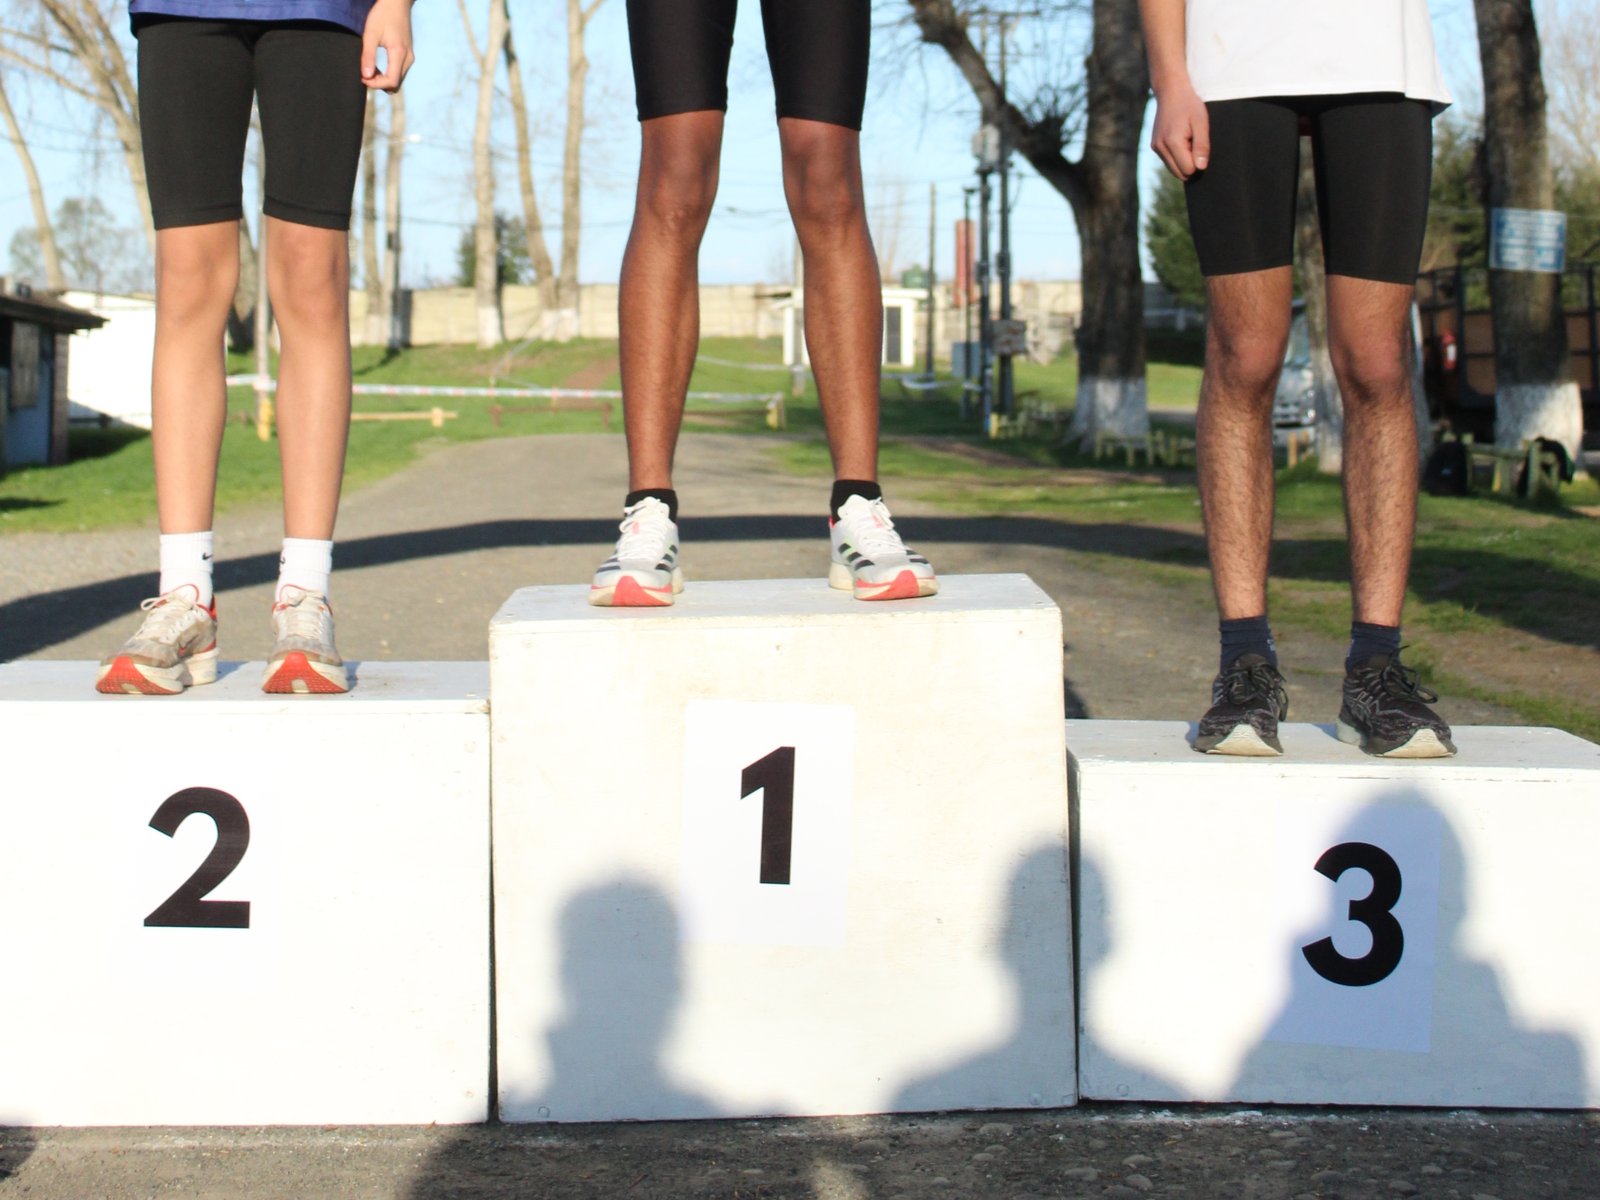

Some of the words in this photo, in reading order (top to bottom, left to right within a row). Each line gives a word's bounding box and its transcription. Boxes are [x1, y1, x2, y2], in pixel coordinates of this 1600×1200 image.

[144, 787, 250, 929] 2
[741, 747, 795, 885] 1
[1302, 842, 1404, 987] 3
